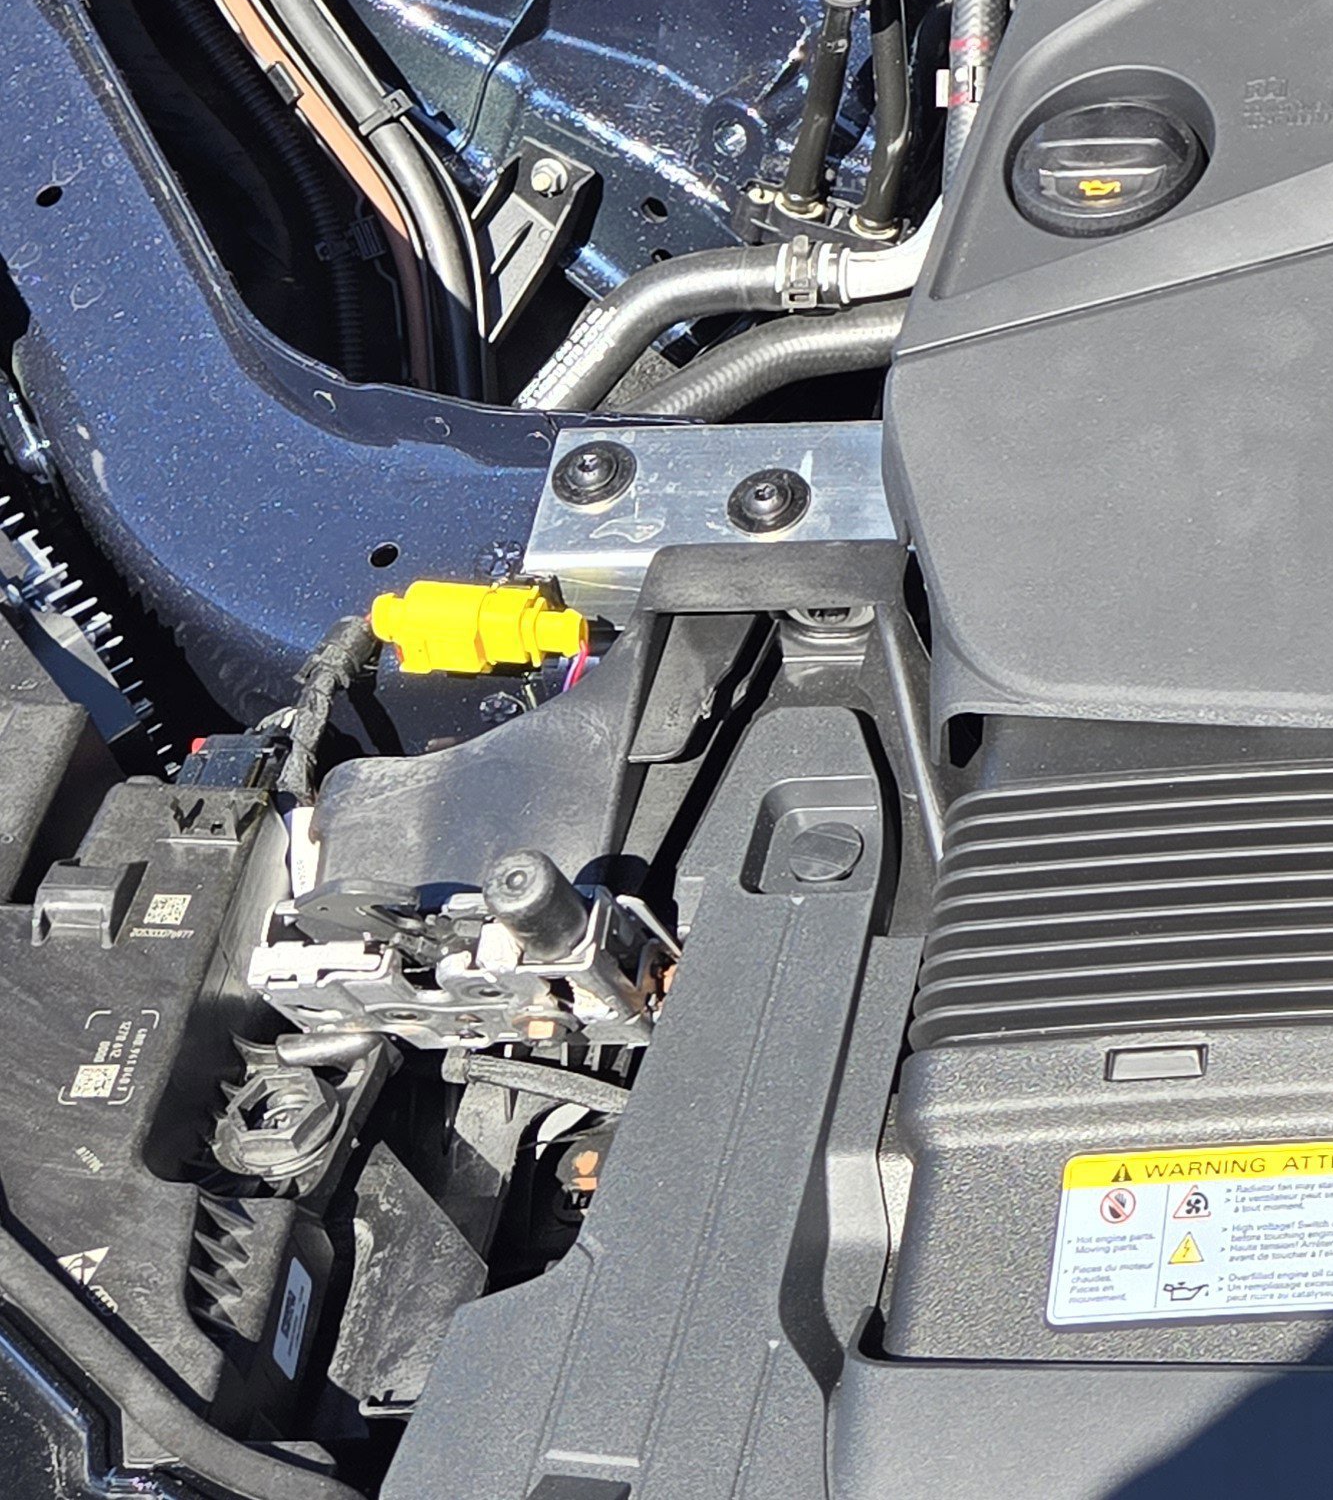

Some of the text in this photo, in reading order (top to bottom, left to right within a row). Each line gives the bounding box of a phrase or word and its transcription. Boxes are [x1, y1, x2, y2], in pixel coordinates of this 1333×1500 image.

[1144, 1157, 1266, 1179] WARNING
[1234, 1194, 1246, 1202] Le
[1231, 1223, 1254, 1234] High
[1076, 1236, 1092, 1244] Hot
[1075, 1245, 1111, 1254] Moving
